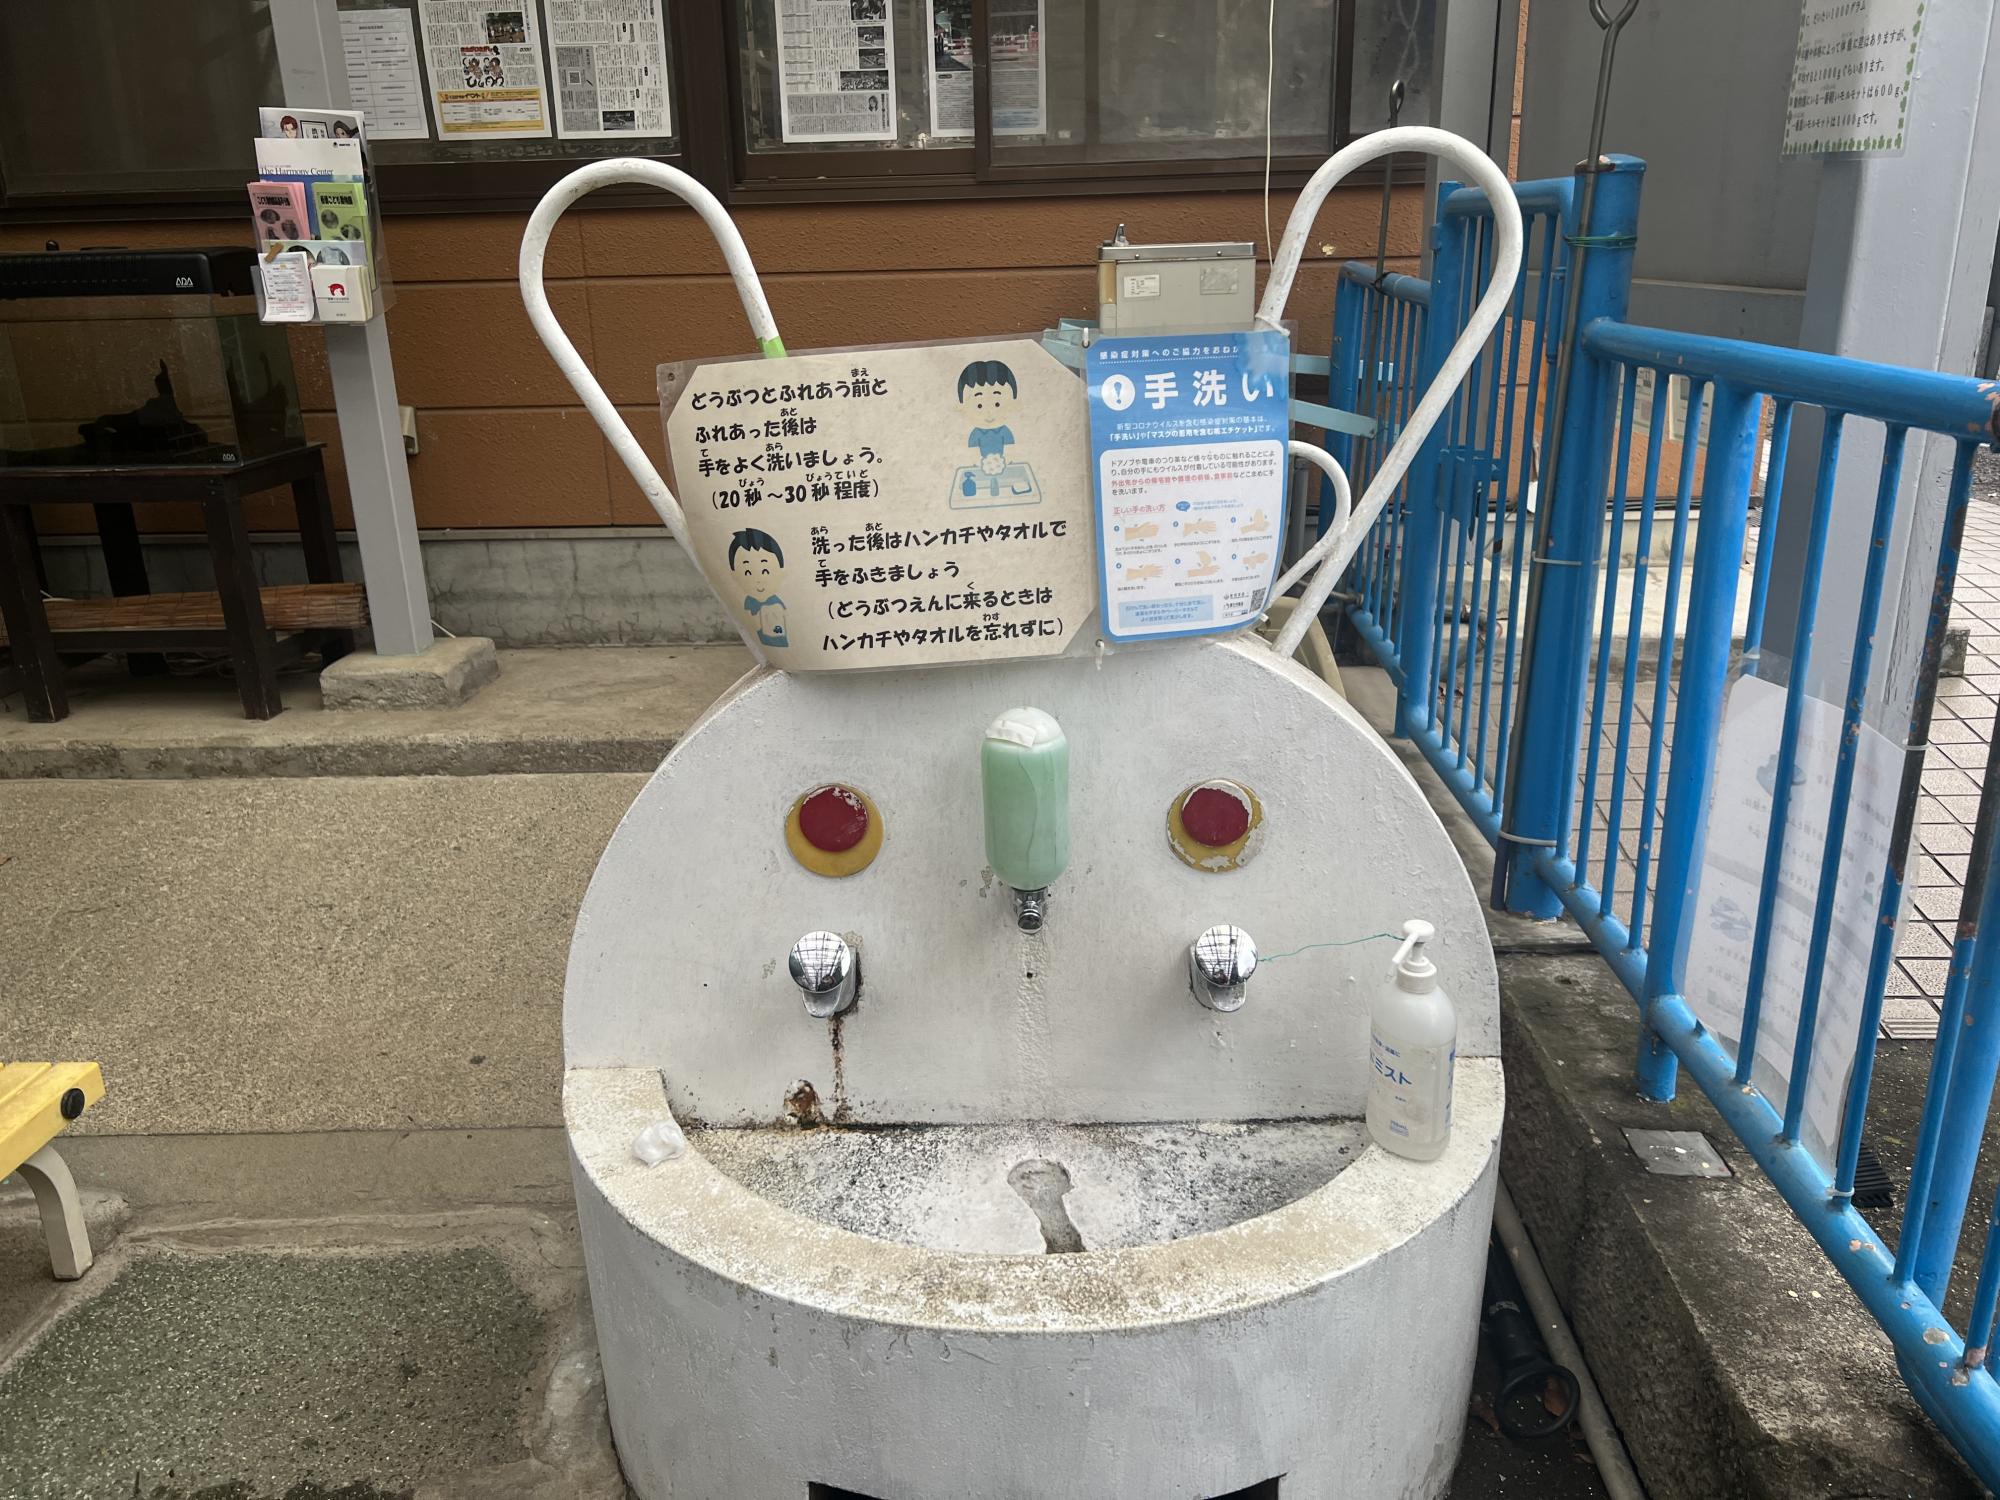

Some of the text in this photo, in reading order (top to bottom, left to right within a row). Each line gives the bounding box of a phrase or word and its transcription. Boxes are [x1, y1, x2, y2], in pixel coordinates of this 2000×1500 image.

[176, 277, 193, 286] ADA
[851, 368, 869, 377] まえ
[692, 378, 889, 410] どうぶつとふれあう前と
[1144, 369, 1274, 410] 手洗い
[780, 407, 798, 417] あと
[695, 417, 817, 443] ふれあった後は
[700, 443, 783, 458] て あら
[698, 448, 885, 478] 手をよく洗いましょう。
[1113, 503, 1165, 515] 正しい手の洗い方
[810, 522, 883, 536] あら あと
[811, 520, 1067, 556] 洗った後はハンカチやタオルで
[818, 559, 826, 567] て
[815, 561, 960, 587] 手をふきましょう
[967, 582, 974, 590] く
[982, 612, 1000, 622] わす
